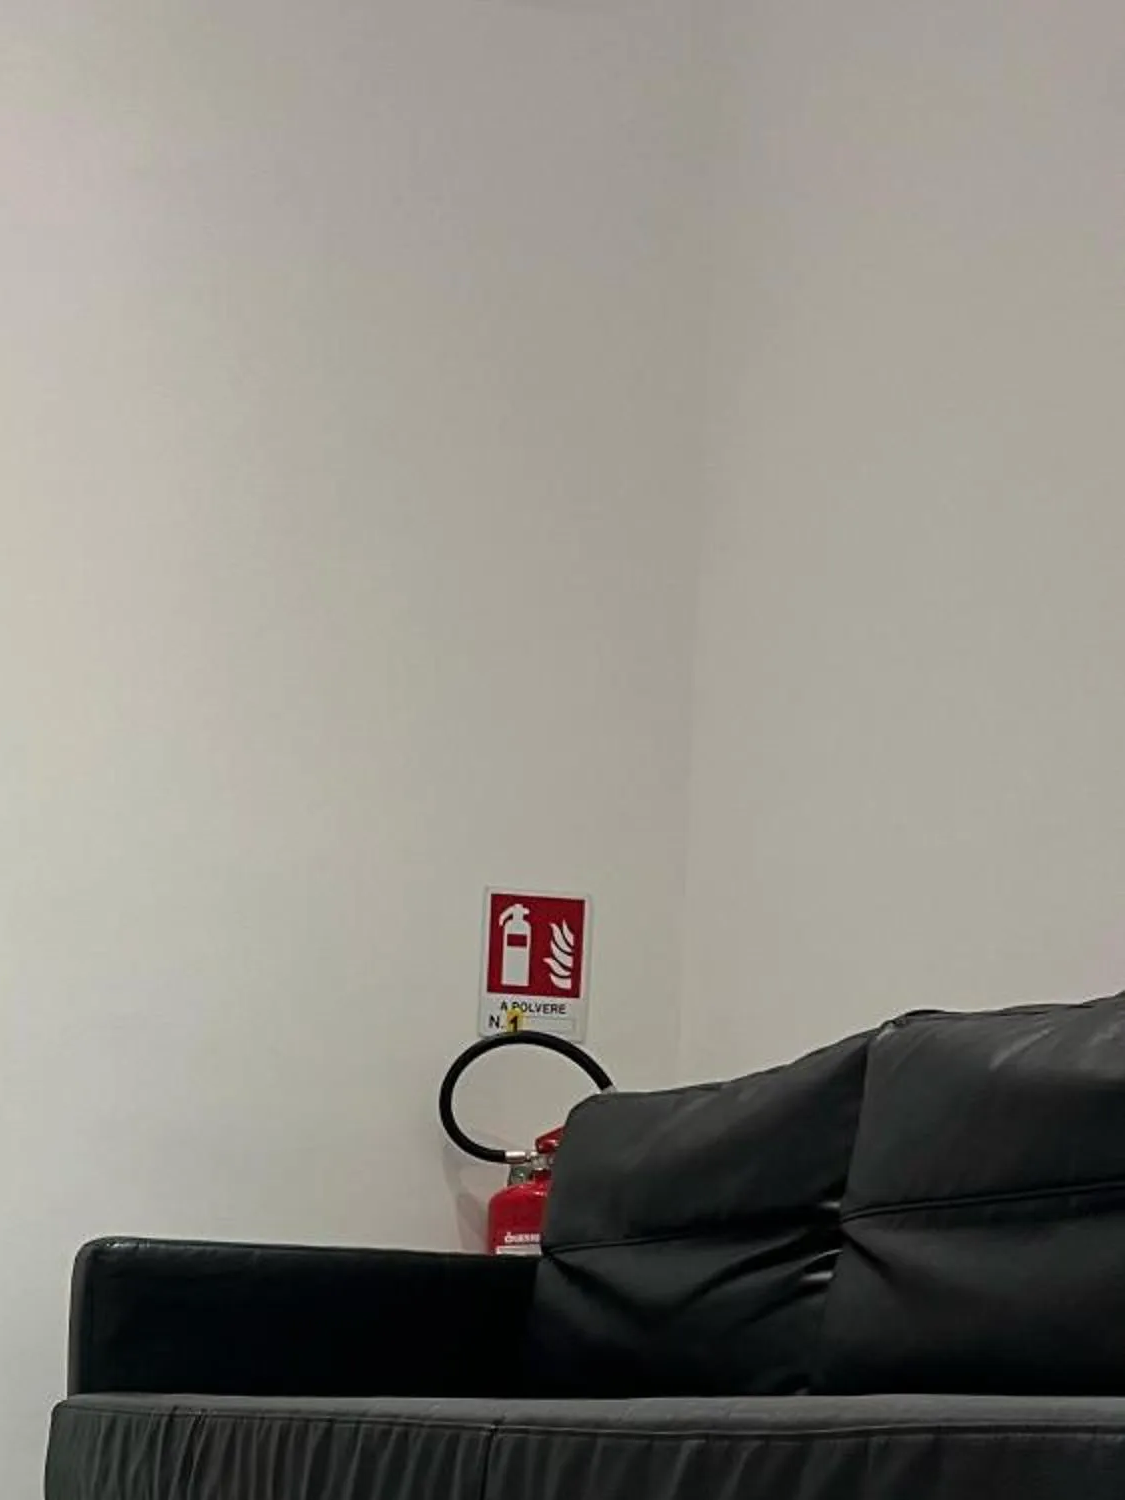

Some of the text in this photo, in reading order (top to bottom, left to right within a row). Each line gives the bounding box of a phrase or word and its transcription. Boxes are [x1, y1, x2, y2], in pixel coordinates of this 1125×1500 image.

[500, 1000, 508, 1011] A
[489, 1014, 518, 1032] N. 1
